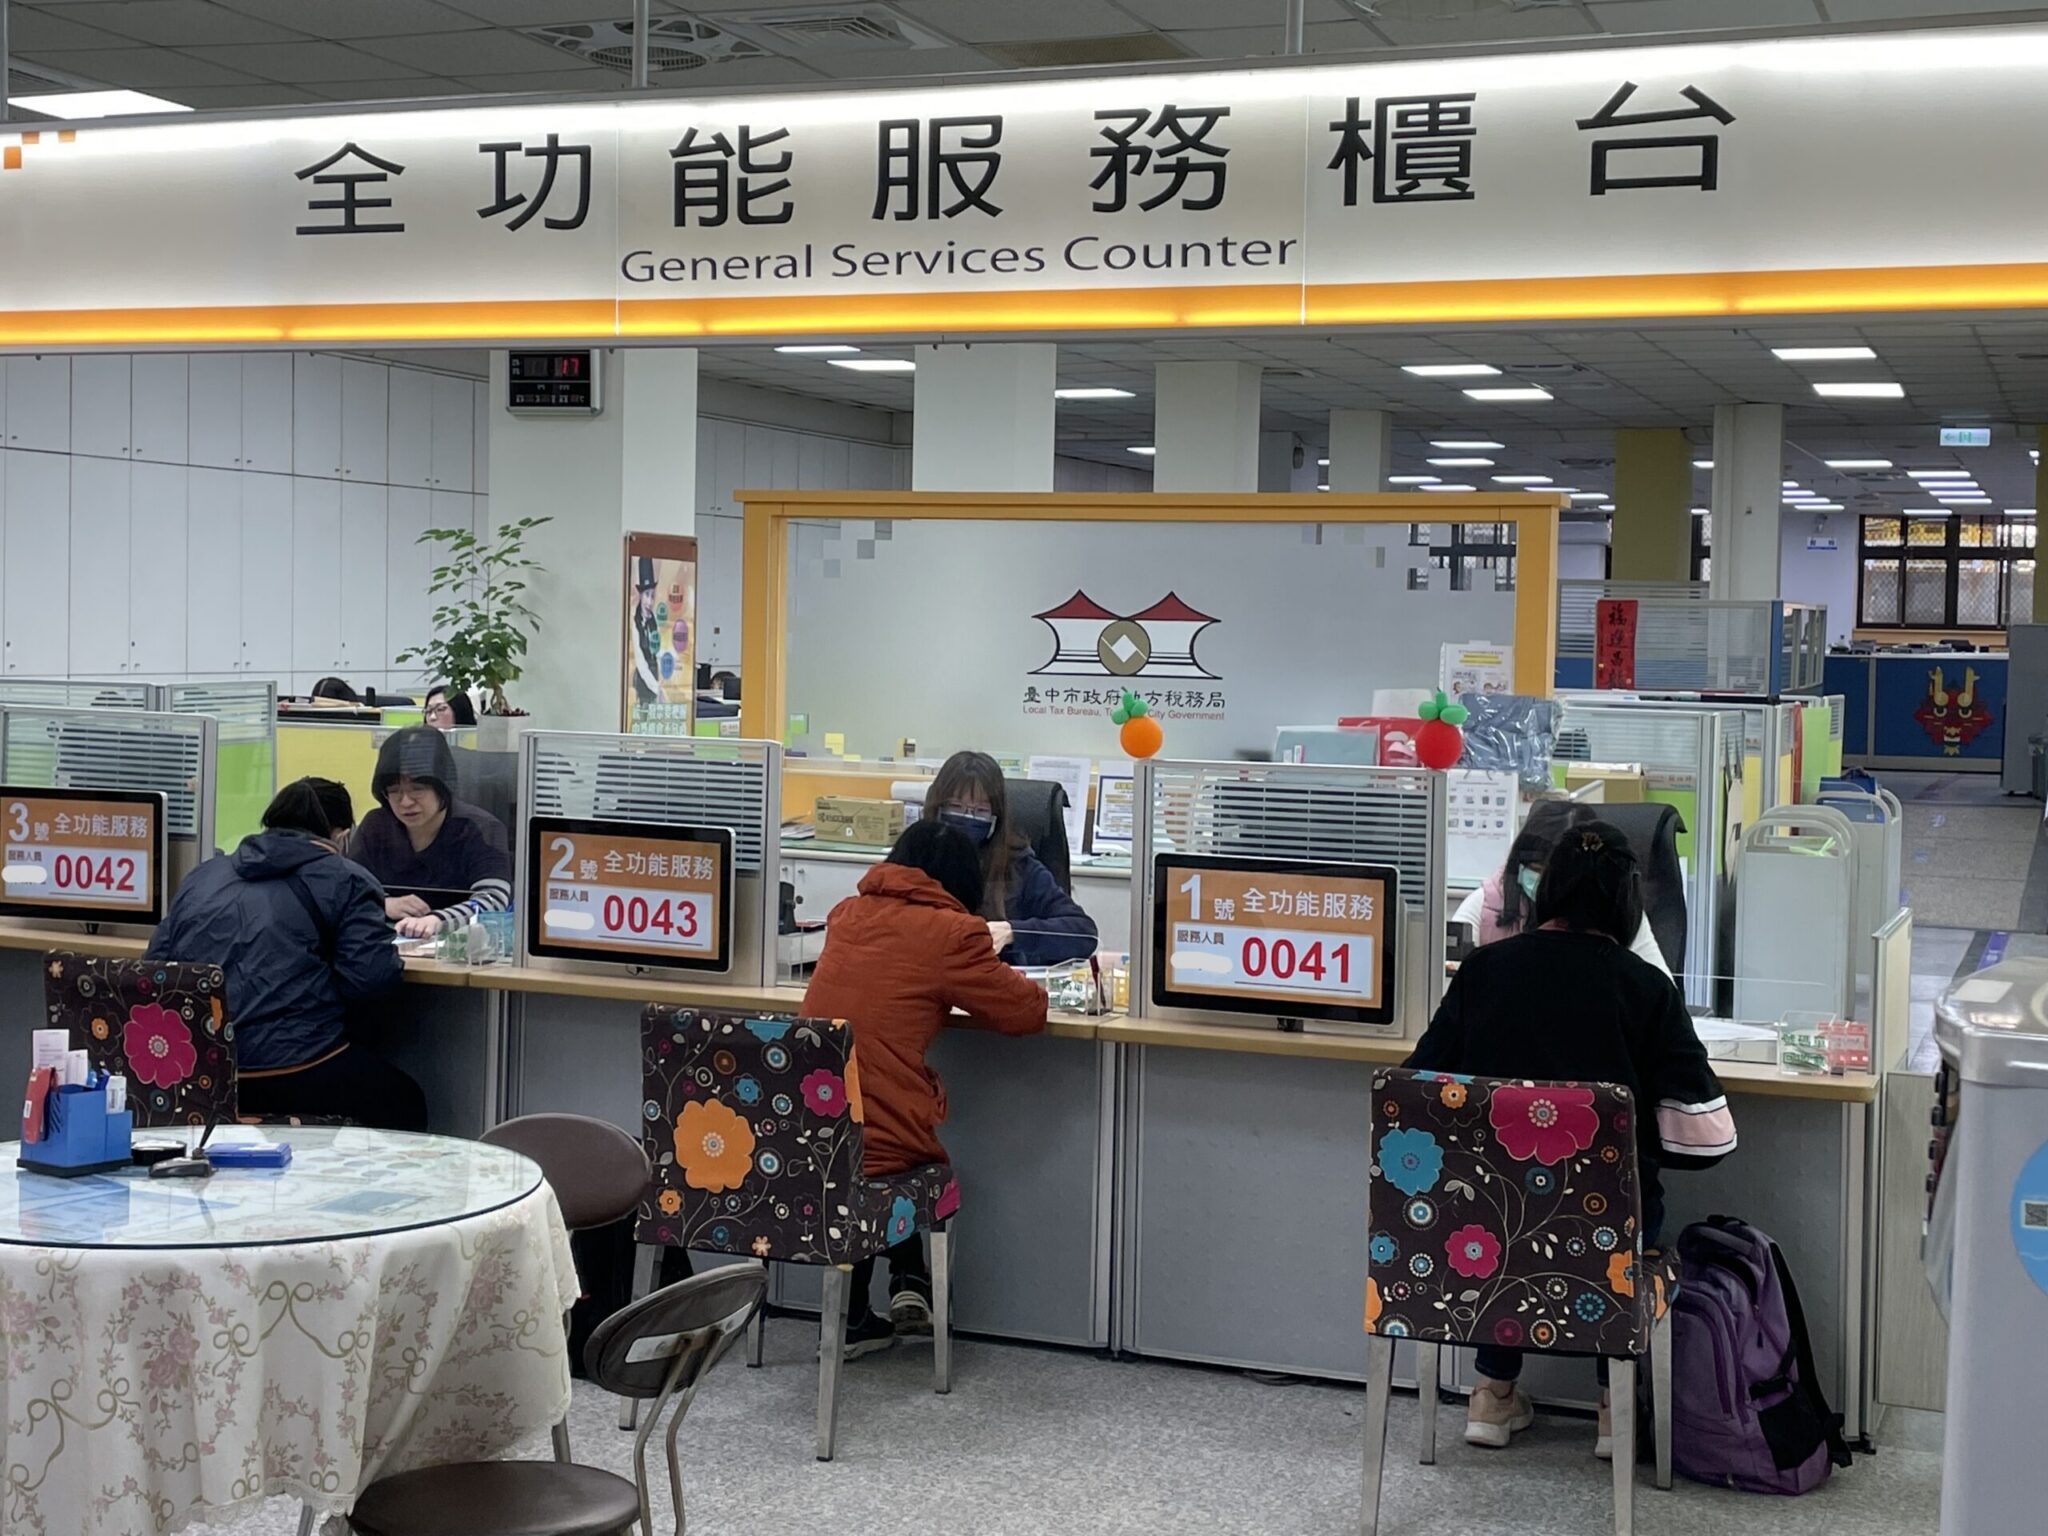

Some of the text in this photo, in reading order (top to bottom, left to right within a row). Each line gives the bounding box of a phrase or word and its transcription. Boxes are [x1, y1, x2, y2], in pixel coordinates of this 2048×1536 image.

[294, 81, 1737, 238] 全功能服務櫃台
[620, 236, 1298, 283] General Services Counter
[1022, 705, 1047, 715] Local
[1049, 705, 1065, 716] Tax
[1167, 709, 1225, 721] Government
[53, 812, 148, 839] 全功能服務
[8, 849, 42, 862] 服務人員
[603, 849, 714, 881] 全功能服務
[54, 853, 135, 892] 0042
[549, 887, 589, 903] 服務人員
[1241, 887, 1374, 922] 全功能服務
[603, 894, 698, 938] 0043
[1176, 928, 1225, 946] 服務人員
[1241, 935, 1350, 984] 0041
